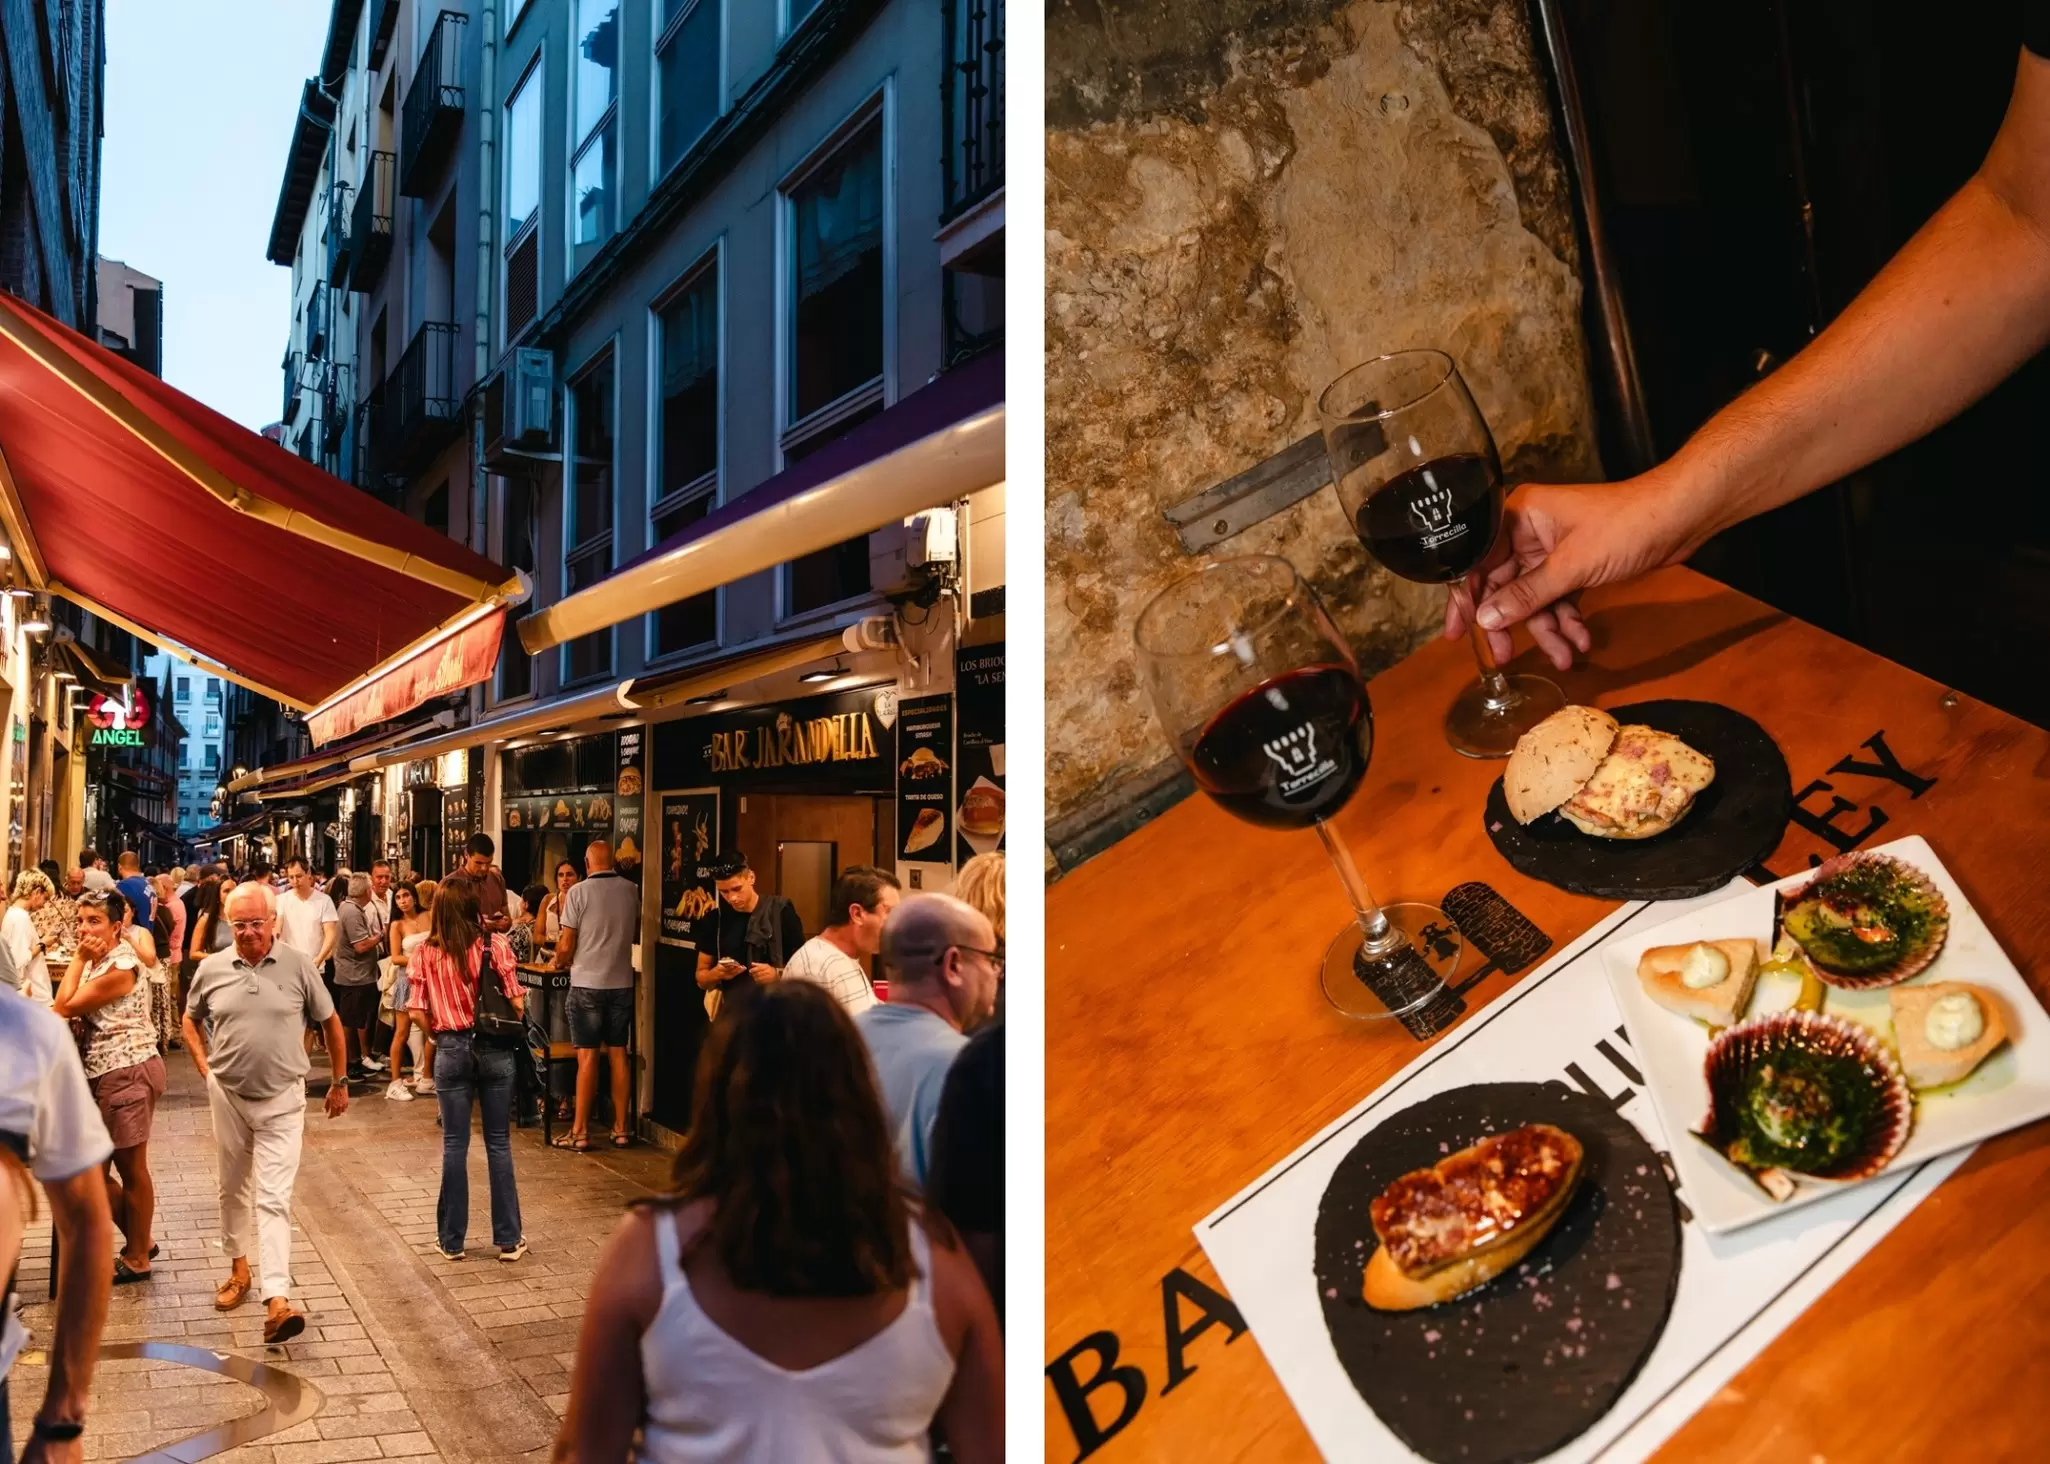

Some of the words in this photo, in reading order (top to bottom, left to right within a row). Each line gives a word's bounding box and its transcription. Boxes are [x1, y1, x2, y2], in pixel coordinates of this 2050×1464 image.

[1421, 523, 1467, 545] Torrecilla
[960, 660, 977, 672] LOS
[92, 729, 145, 745] ANGEL
[711, 730, 751, 772] BAR
[753, 712, 880, 769] JARANDILLA
[551, 976, 571, 987] CO
